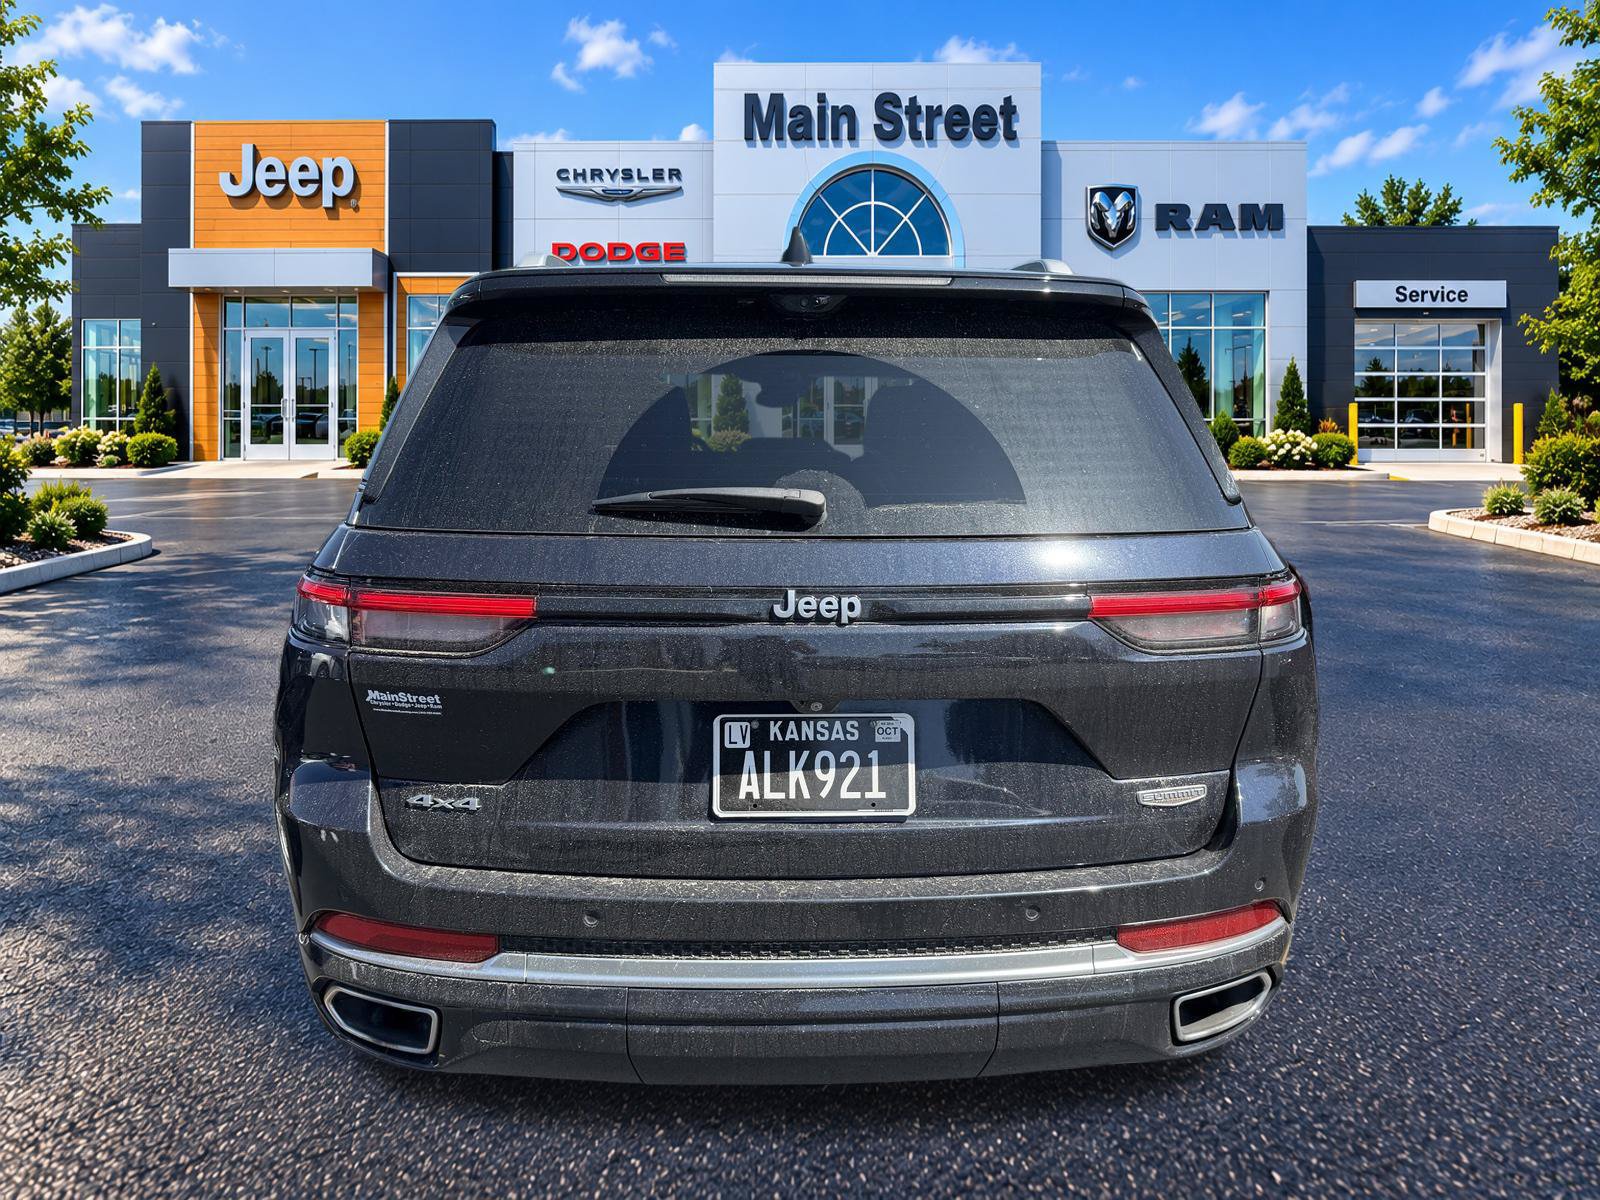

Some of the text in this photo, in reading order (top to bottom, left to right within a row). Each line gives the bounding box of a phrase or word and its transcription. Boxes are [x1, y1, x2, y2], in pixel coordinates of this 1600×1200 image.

[744, 92, 1018, 141] Main Street
[218, 143, 355, 208] Jeep
[556, 168, 683, 182] CHRYSLER
[1155, 203, 1284, 231] RAM
[551, 242, 687, 262] DODGE
[1395, 285, 1469, 303] Service
[773, 589, 862, 624] Jeep
[365, 689, 441, 704] MainStreet
[728, 720, 899, 746] LV KANSAS OCT
[738, 750, 887, 800] ALK921
